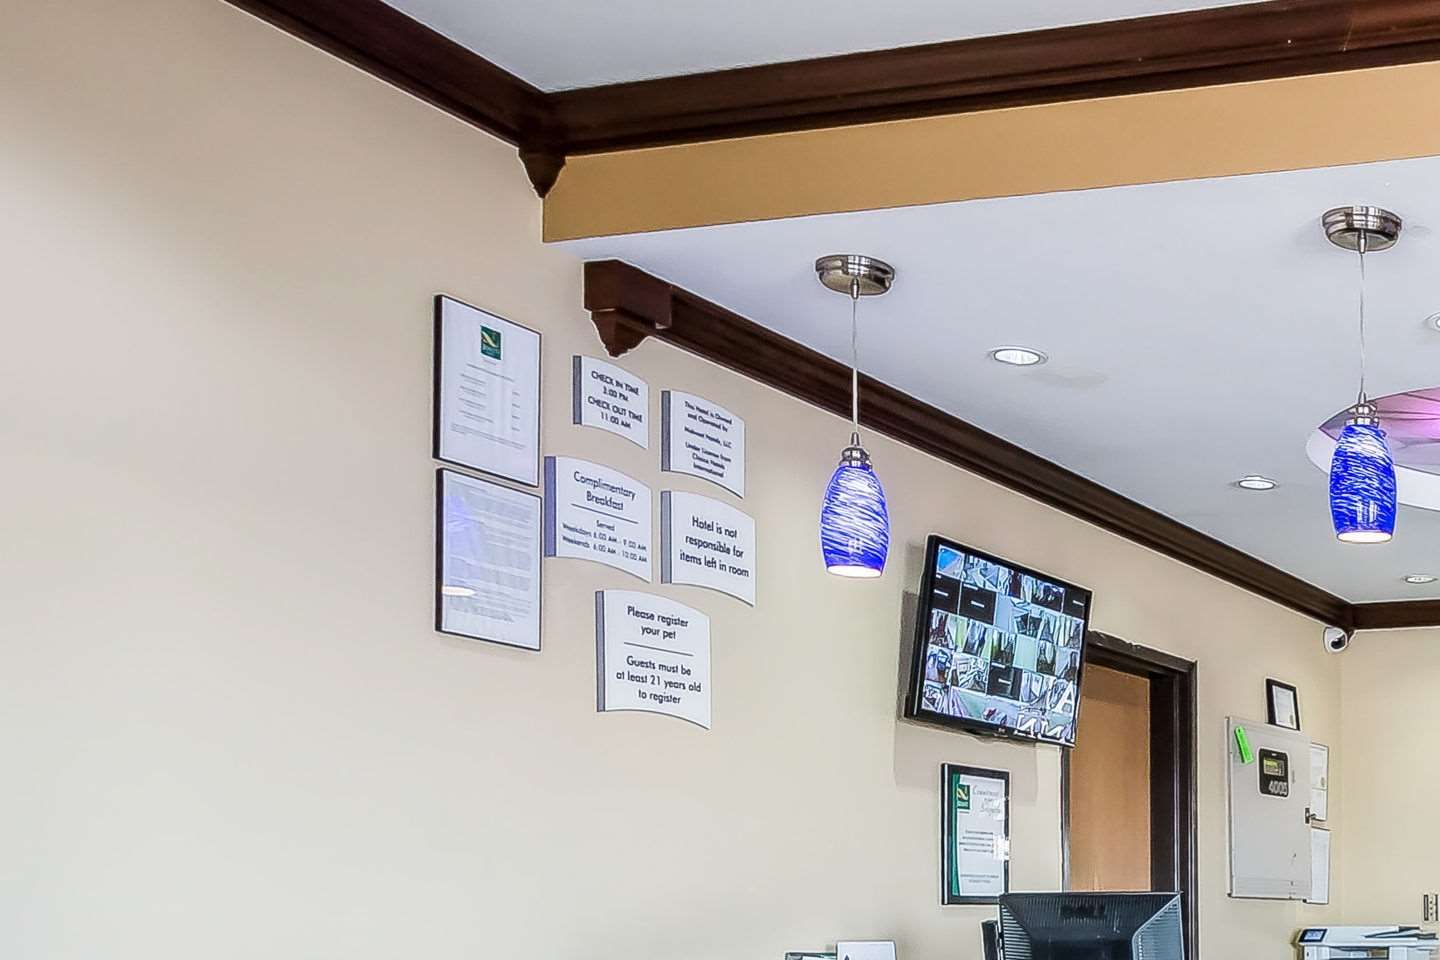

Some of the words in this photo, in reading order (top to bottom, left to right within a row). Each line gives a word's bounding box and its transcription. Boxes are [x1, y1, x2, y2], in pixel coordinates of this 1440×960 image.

[591, 370, 614, 386] CHECK
[624, 382, 640, 396] TIME
[587, 395, 611, 410] CHECK
[611, 404, 627, 416] OUT
[628, 409, 643, 423] TIME
[573, 471, 636, 501] Complimentary
[586, 490, 624, 511] Breakfast
[691, 515, 714, 532] Hotel
[716, 522, 723, 535] is
[724, 527, 738, 539] not
[685, 535, 731, 557] responsible
[732, 544, 744, 559] for
[679, 549, 702, 566] items
[703, 555, 718, 570] left
[718, 559, 727, 571] in
[728, 566, 750, 578] room
[627, 605, 655, 621] Please
[656, 614, 689, 628] register
[641, 625, 660, 636] your
[662, 629, 676, 641] pet
[626, 655, 656, 670] Guests
[658, 662, 679, 674] must
[680, 664, 692, 677] be
[615, 670, 625, 680] at
[627, 670, 648, 684] least
[649, 673, 661, 686] 21
[663, 678, 687, 690] years
[688, 681, 702, 693] old
[638, 688, 647, 699] to
[649, 691, 682, 704] register
